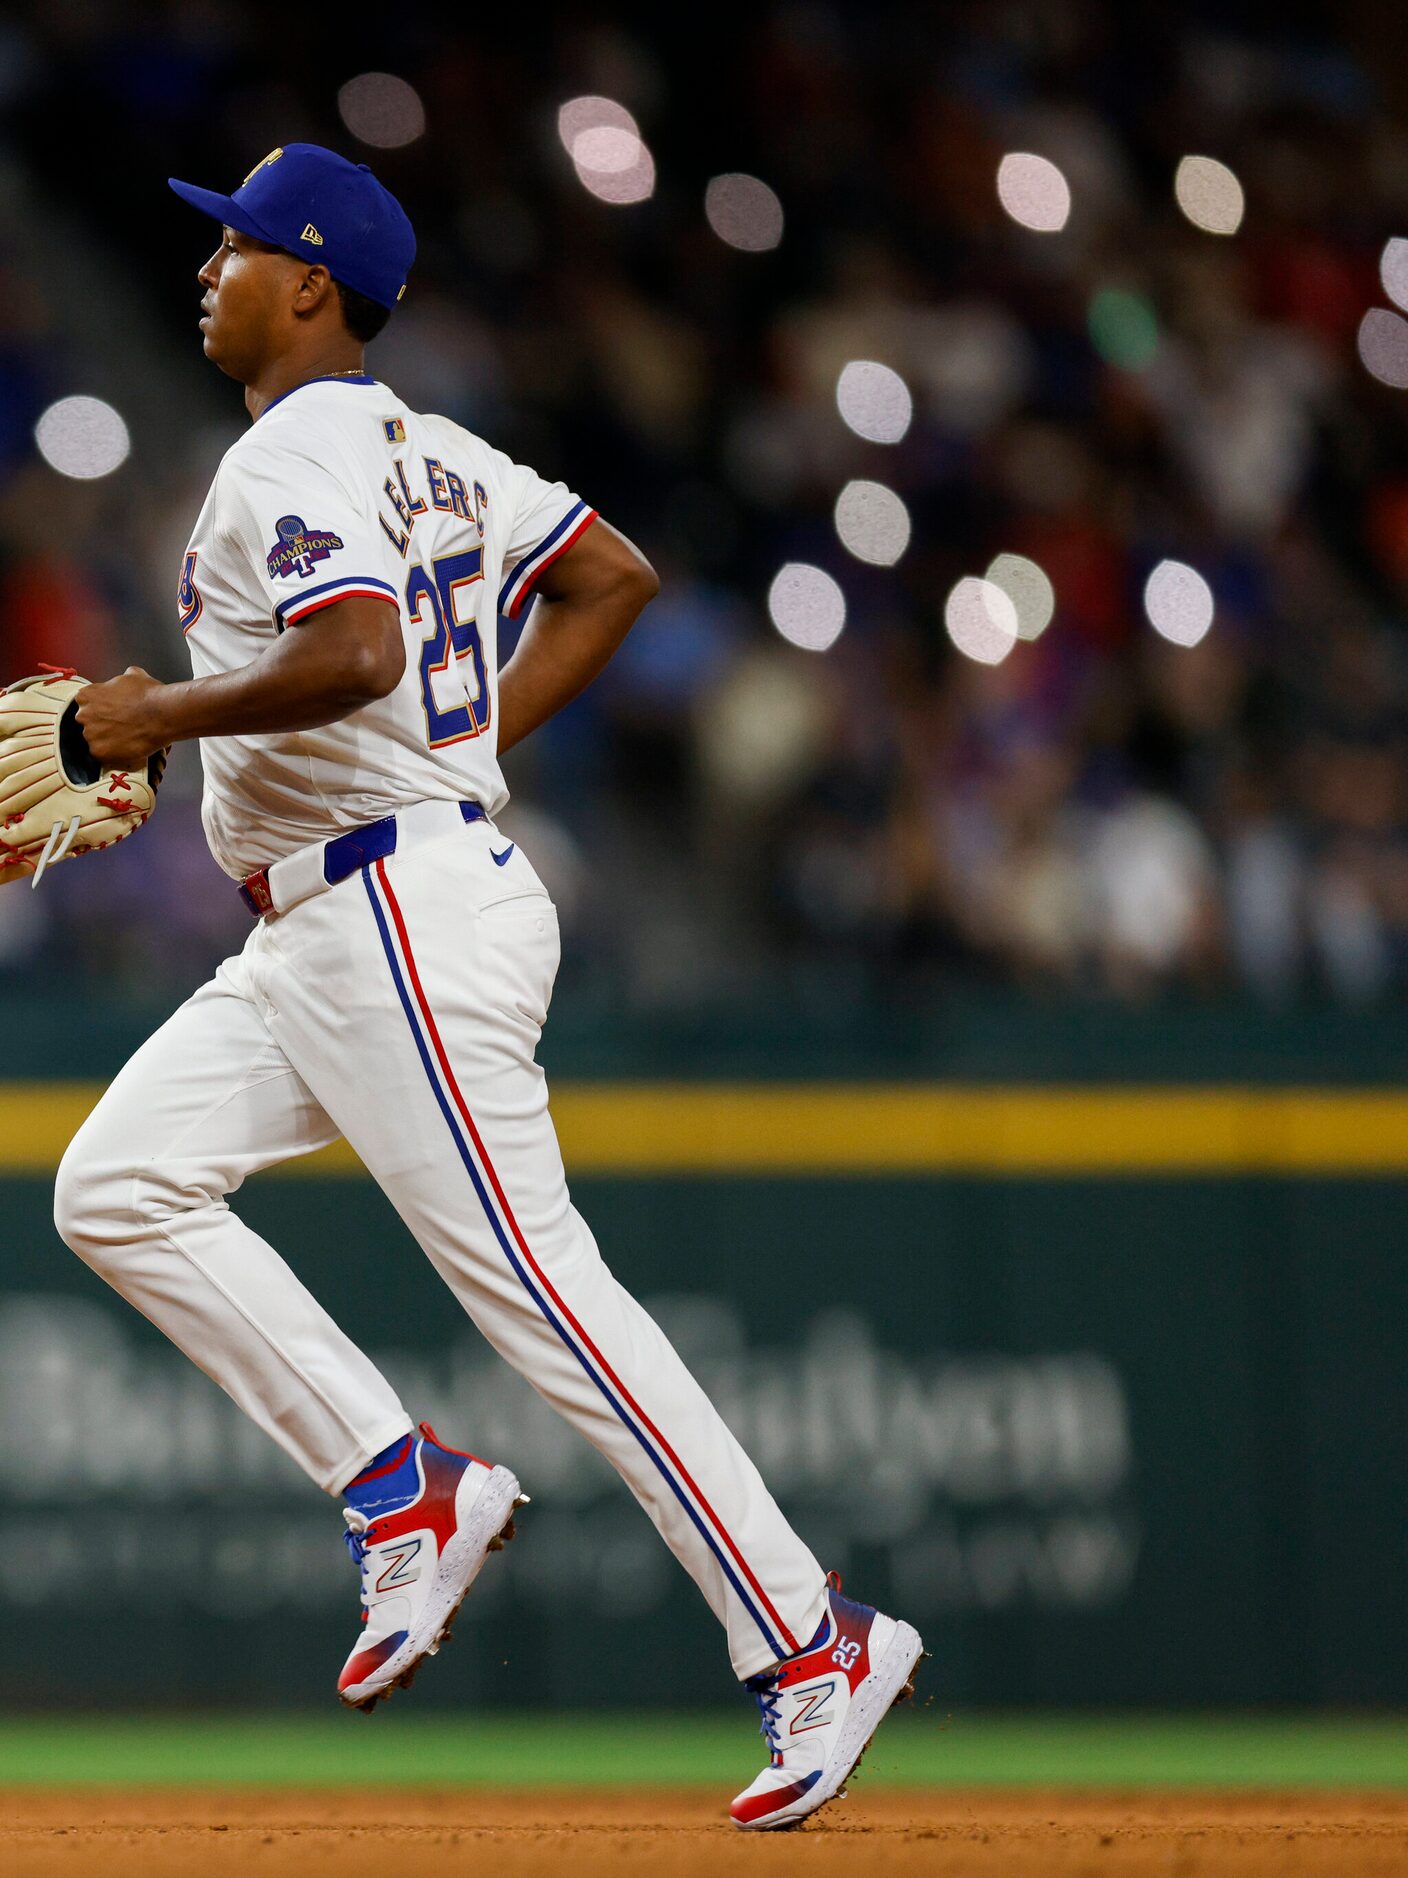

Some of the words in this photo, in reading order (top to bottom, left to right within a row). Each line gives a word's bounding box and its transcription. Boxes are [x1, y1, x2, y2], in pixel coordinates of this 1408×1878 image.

[267, 536, 342, 577] CHAMPIONS
[405, 543, 491, 750] 25
[832, 1635, 862, 1671] 25
